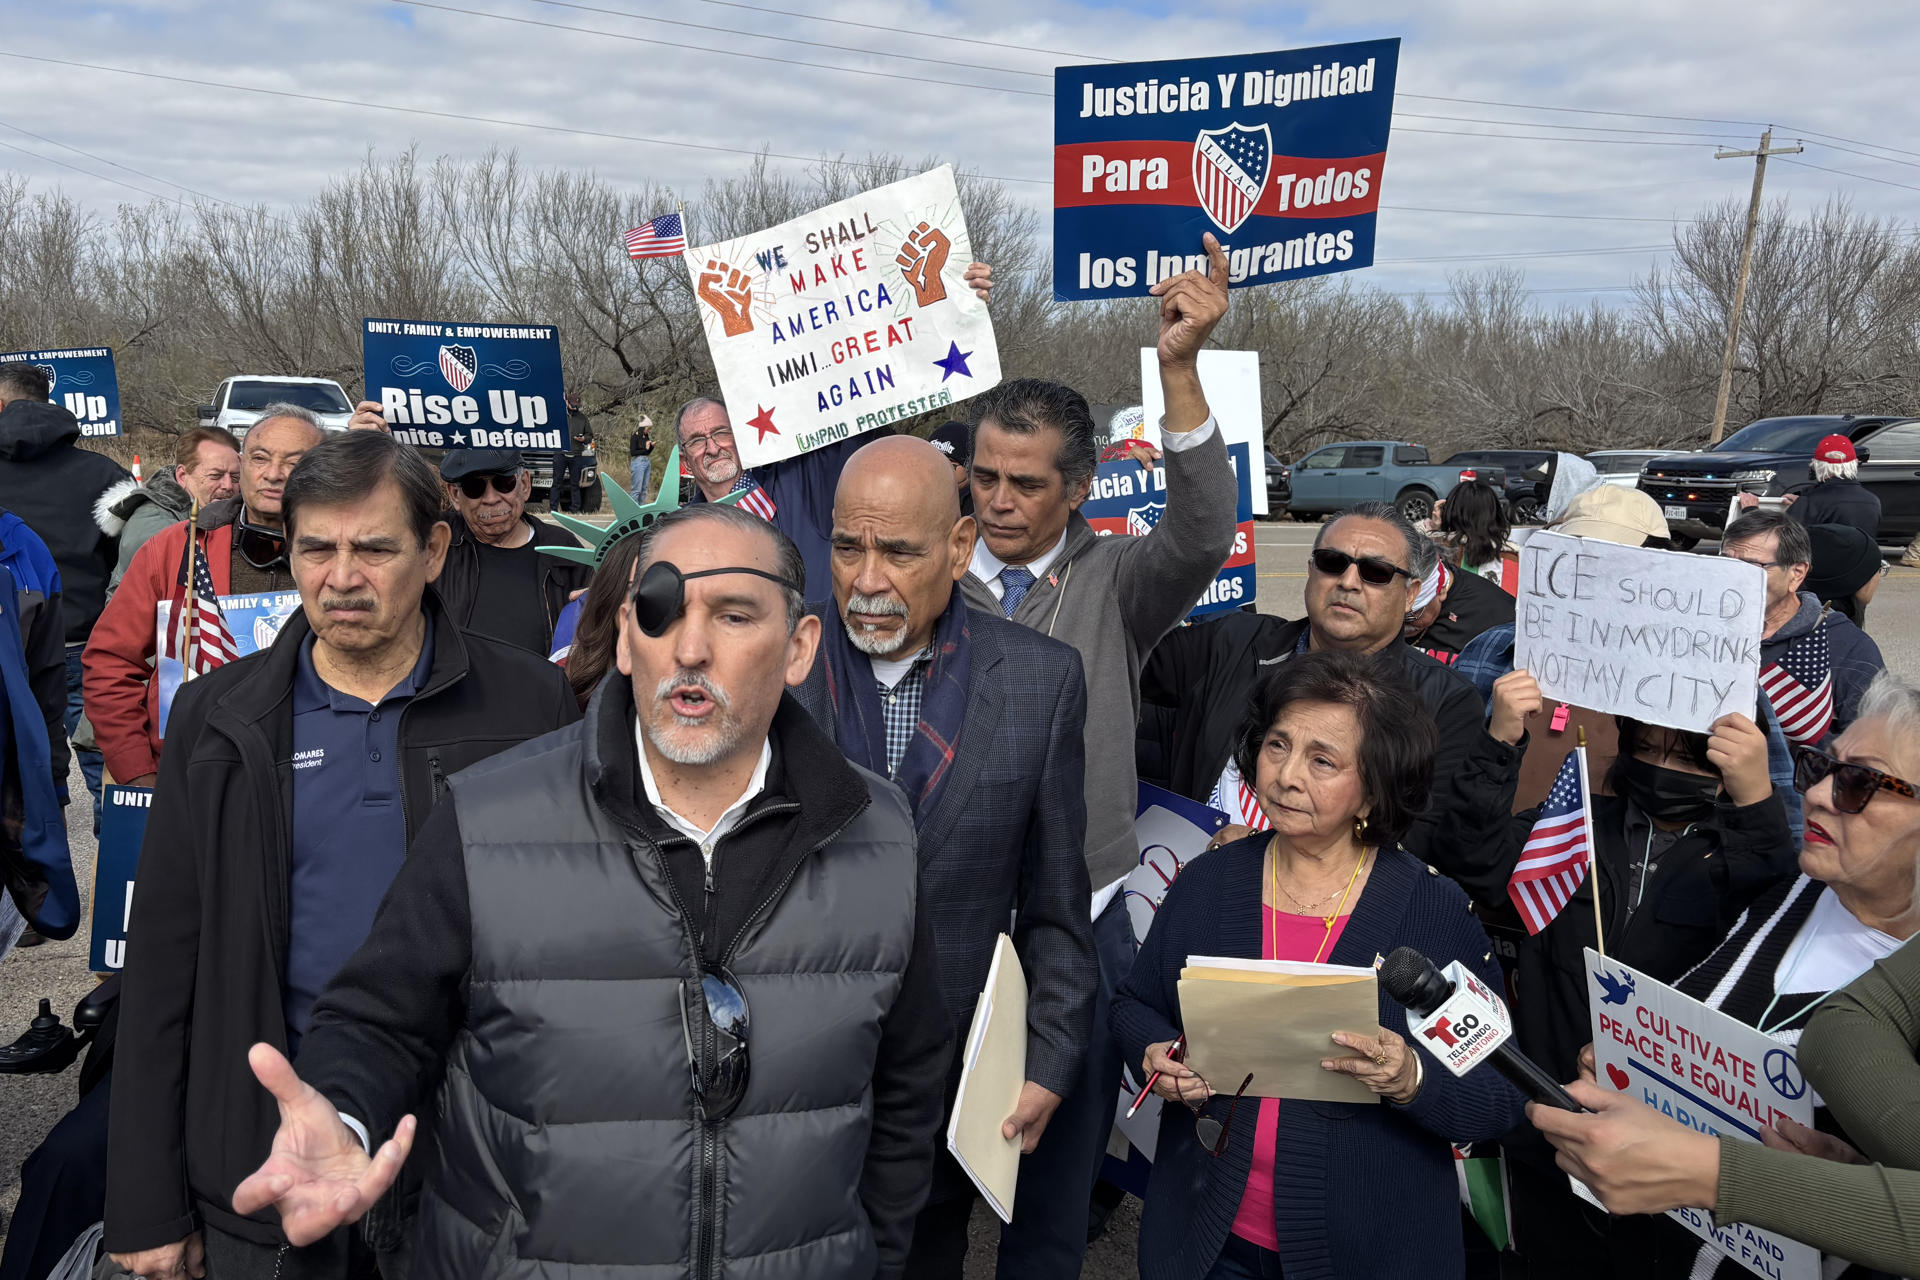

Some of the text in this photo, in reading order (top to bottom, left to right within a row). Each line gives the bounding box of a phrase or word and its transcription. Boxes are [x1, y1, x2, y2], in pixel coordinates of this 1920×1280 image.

[1080, 58, 1376, 118] Justicia Y Dignidad
[1082, 155, 1371, 212] Para Todos
[1204, 143, 1256, 197] LULAC
[756, 212, 878, 272] WE SHALL
[789, 248, 868, 295] MAKE
[1079, 253, 1137, 290] los
[368, 321, 552, 340] UNITY, FAMILY & EMPOWERMENT
[771, 282, 894, 345] AMERICA
[0, 349, 107, 363] AMILY & EMPOWERMENT
[64, 392, 108, 421] Up
[381, 387, 548, 428] Rise Up
[817, 364, 897, 413] AGAIN
[392, 428, 562, 449] nite Defend
[796, 387, 952, 452] UNPAID PROTESTER
[1135, 470, 1147, 493] Y
[220, 597, 258, 610] AMILY
[261, 597, 272, 606] &
[1525, 546, 1745, 620] ICE SHOULD
[1525, 602, 1554, 640] BE
[1568, 611, 1611, 648] IN
[1671, 626, 1757, 664] DRINK
[1527, 648, 1736, 720] NOT MY CITY
[292, 759, 322, 770] resident
[293, 749, 324, 761] OMARES
[113, 790, 152, 808] UNIT
[1446, 1023, 1492, 1062] TELEMUNDO
[1452, 1013, 1480, 1039] 60
[1636, 1005, 1756, 1088] CULTIVATE
[1452, 1028, 1499, 1068] SAN ANTONIO
[1599, 1012, 1804, 1129] PEACE & EQUALIT
[1707, 1221, 1736, 1252] WE
[1727, 1221, 1785, 1262] TAND
